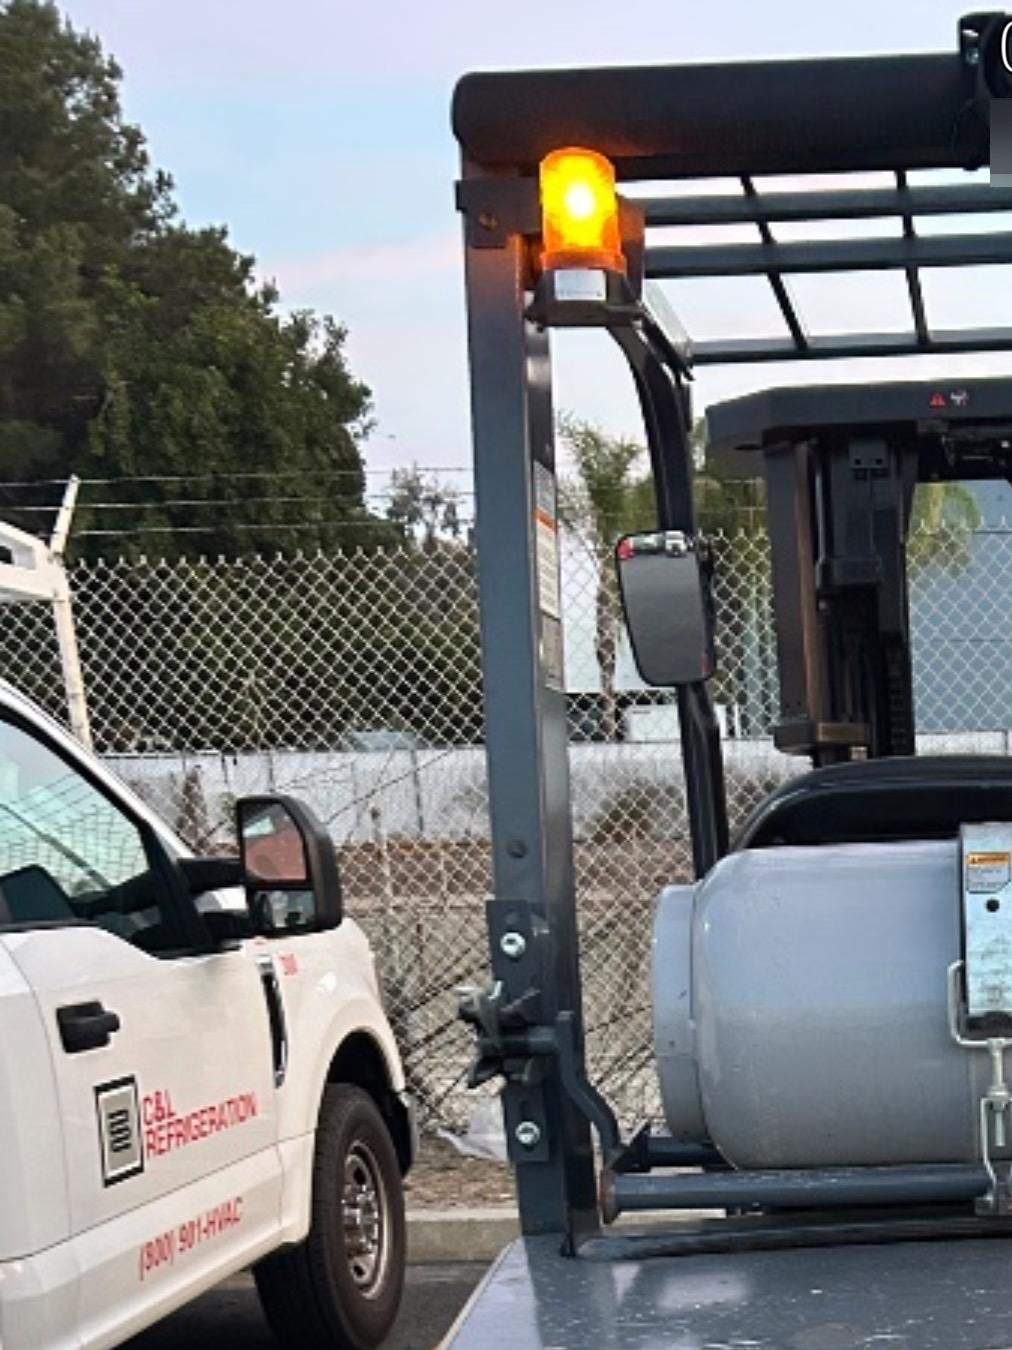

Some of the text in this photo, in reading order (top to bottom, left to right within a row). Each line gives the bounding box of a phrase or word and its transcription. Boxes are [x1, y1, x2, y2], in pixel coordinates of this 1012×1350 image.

[142, 1089, 176, 1126] C&L
[145, 1092, 257, 1159] REFRIGERATION
[178, 1196, 243, 1252] 901-HVAC
